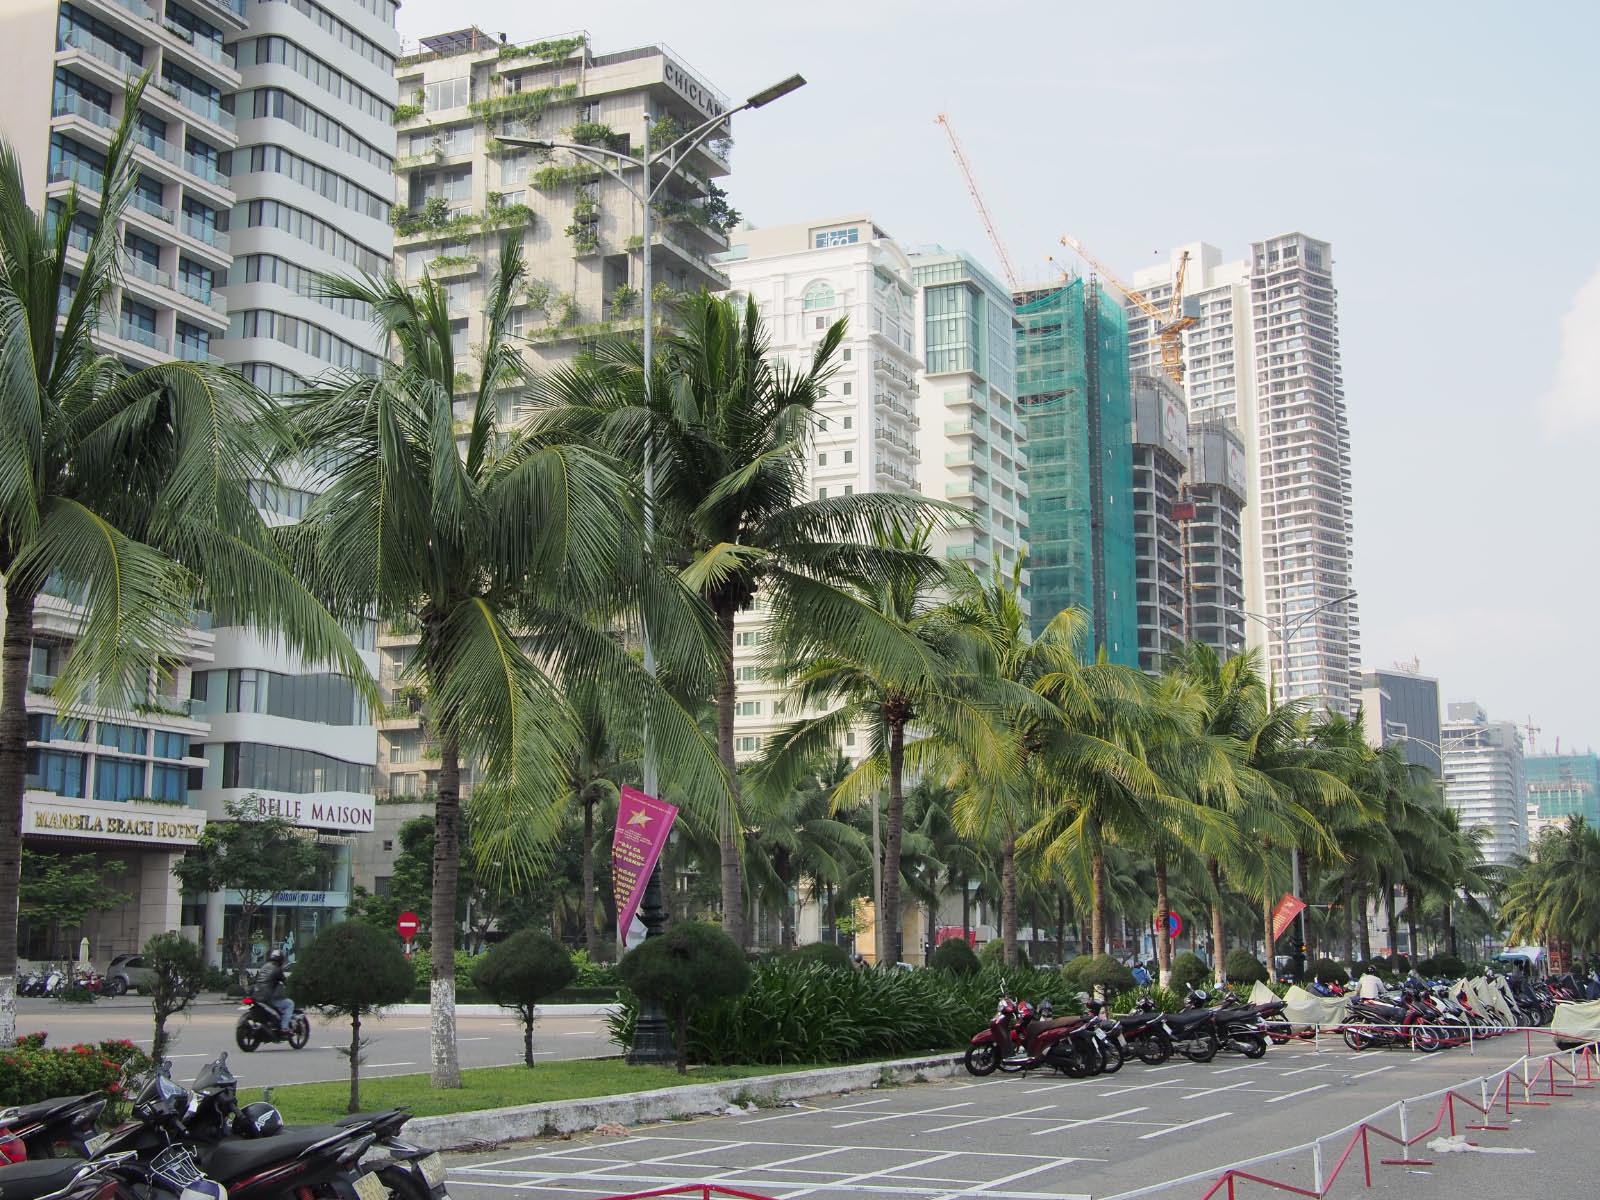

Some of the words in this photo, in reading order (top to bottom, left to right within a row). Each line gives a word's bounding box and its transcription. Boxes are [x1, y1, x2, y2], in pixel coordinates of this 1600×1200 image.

[35, 810, 103, 832] MANDILA
[107, 816, 153, 836] BEACH
[156, 821, 200, 839] HOTEL
[259, 797, 301, 819] BELLE
[311, 803, 372, 825] MAISON
